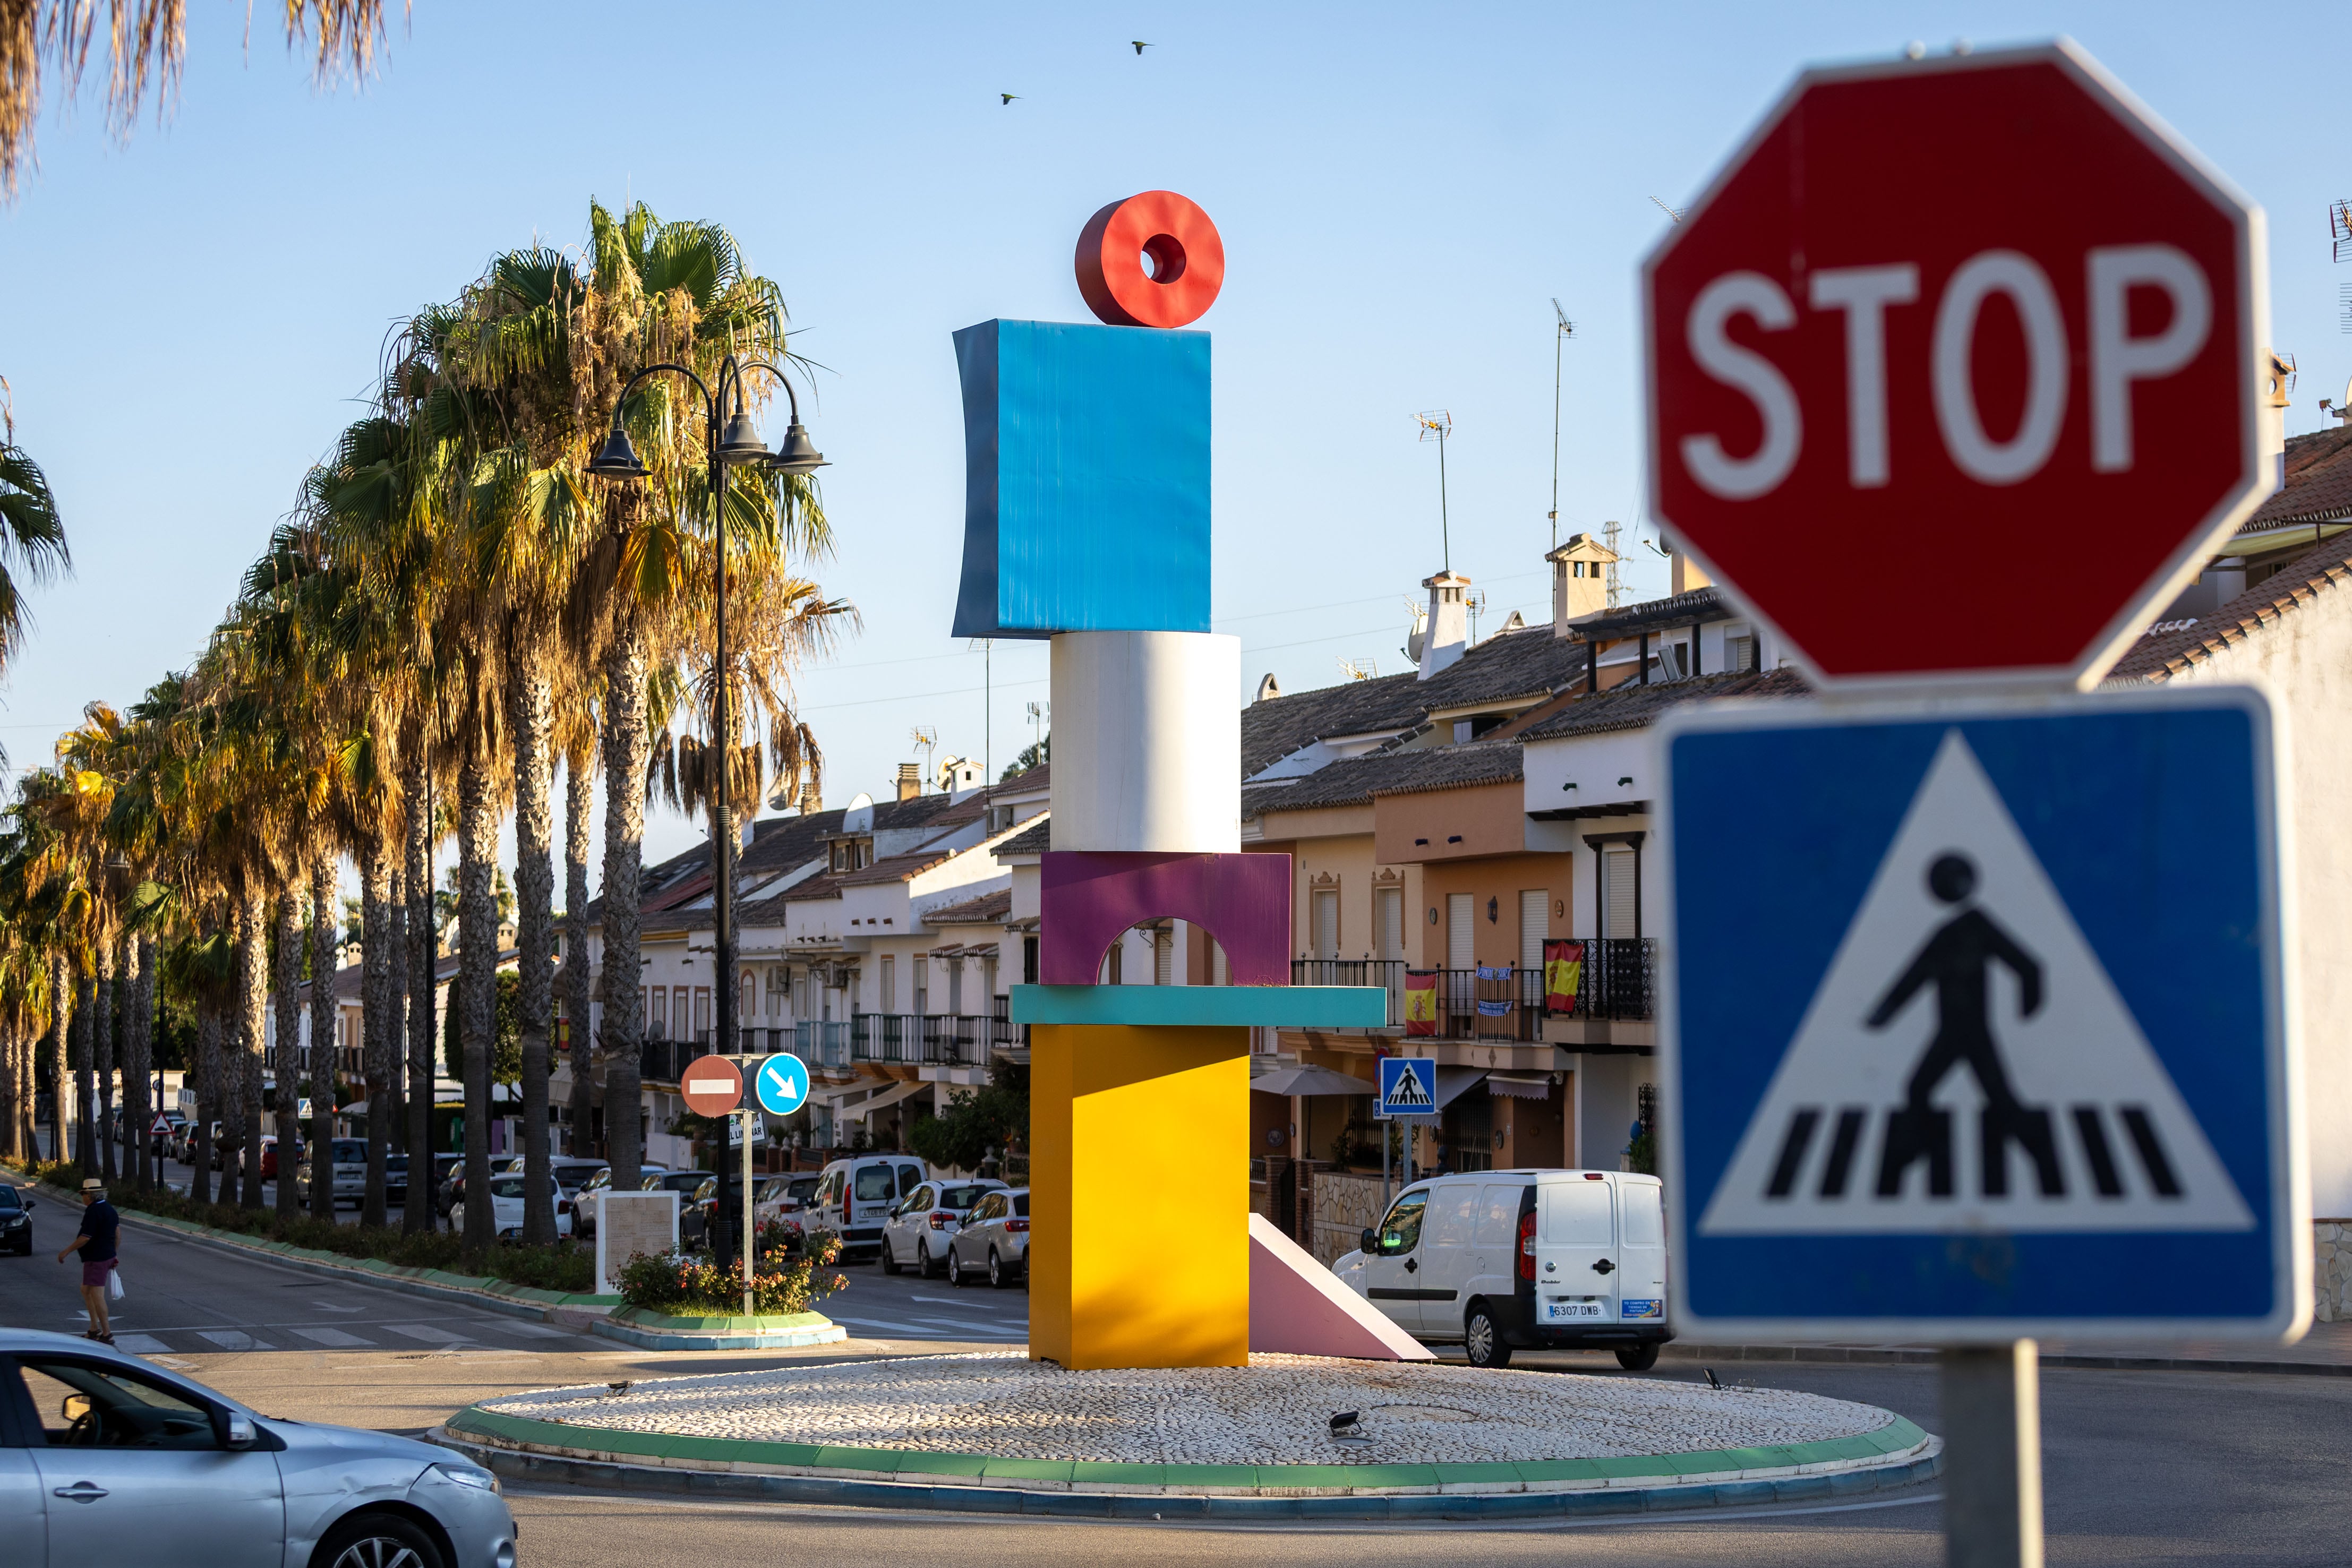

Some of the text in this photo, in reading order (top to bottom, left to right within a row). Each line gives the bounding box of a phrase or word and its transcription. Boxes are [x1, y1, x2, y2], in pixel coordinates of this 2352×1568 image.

[1680, 243, 2214, 502] STOP
[1498, 969, 1509, 979] SUR
[1554, 1306, 1598, 1315] 6307 DWB
